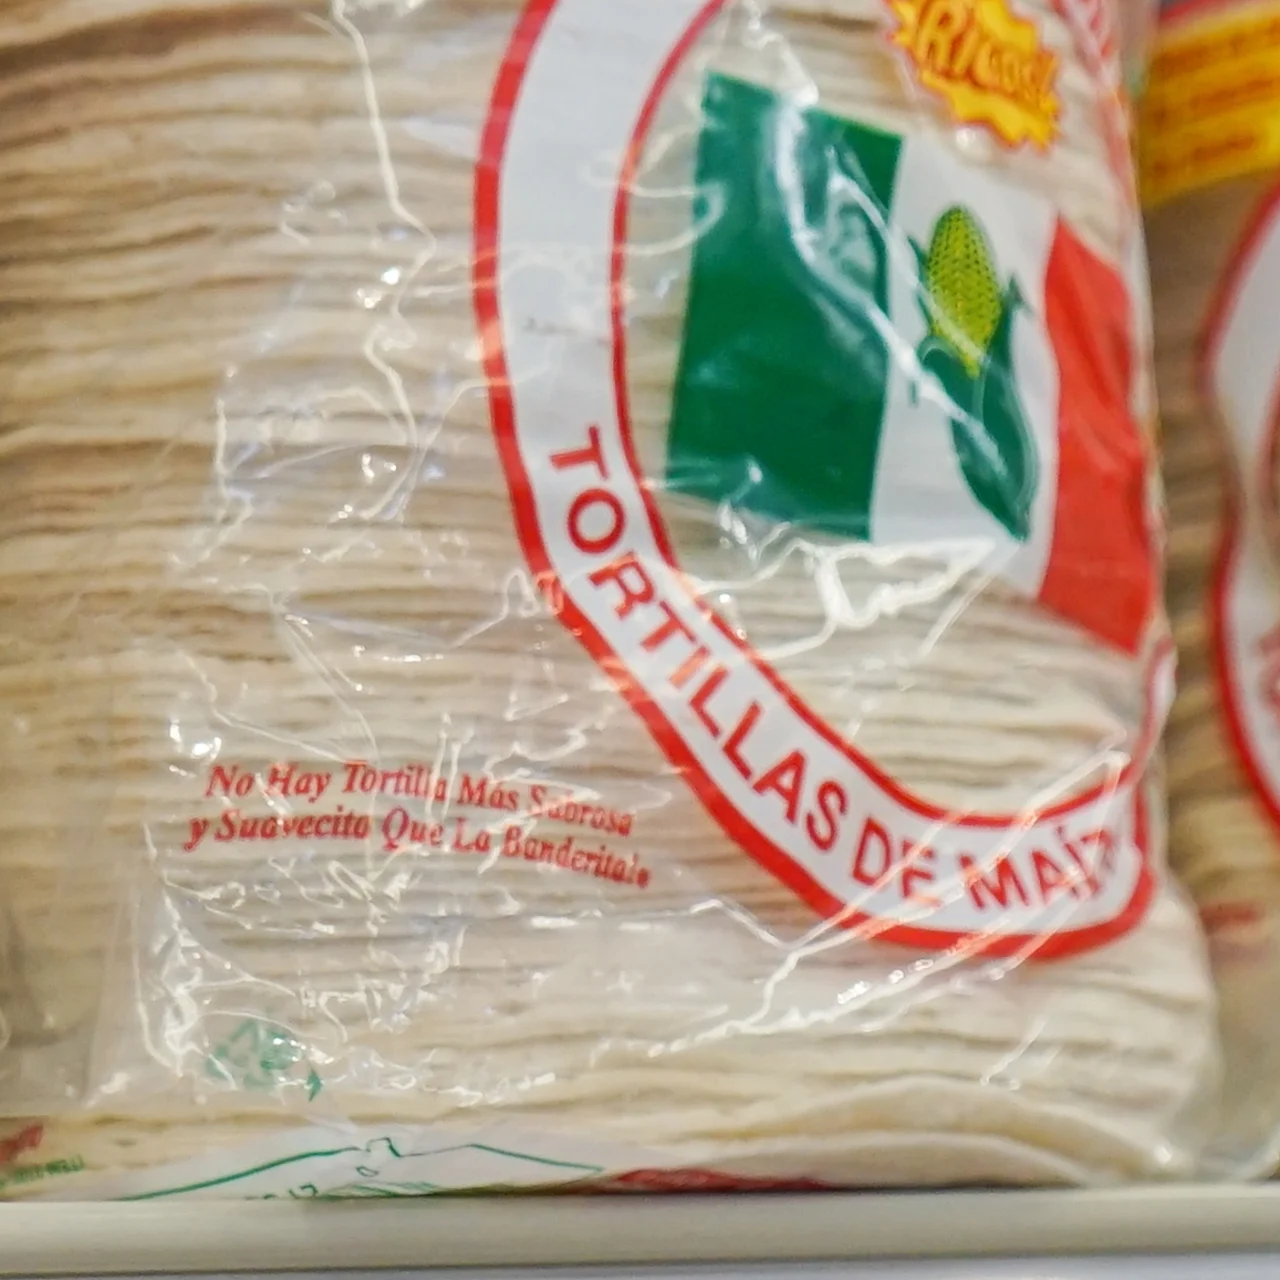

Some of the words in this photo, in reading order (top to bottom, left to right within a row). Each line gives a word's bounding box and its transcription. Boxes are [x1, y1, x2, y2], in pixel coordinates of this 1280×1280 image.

[551, 427, 849, 852] TORTILLAS
[852, 820, 939, 909] DE
[206, 764, 253, 799] No
[267, 763, 331, 807] Hay
[343, 761, 447, 804] Tortilla
[456, 772, 519, 812] Más
[184, 816, 210, 853] y
[382, 806, 445, 852] Que
[452, 817, 493, 854] La
